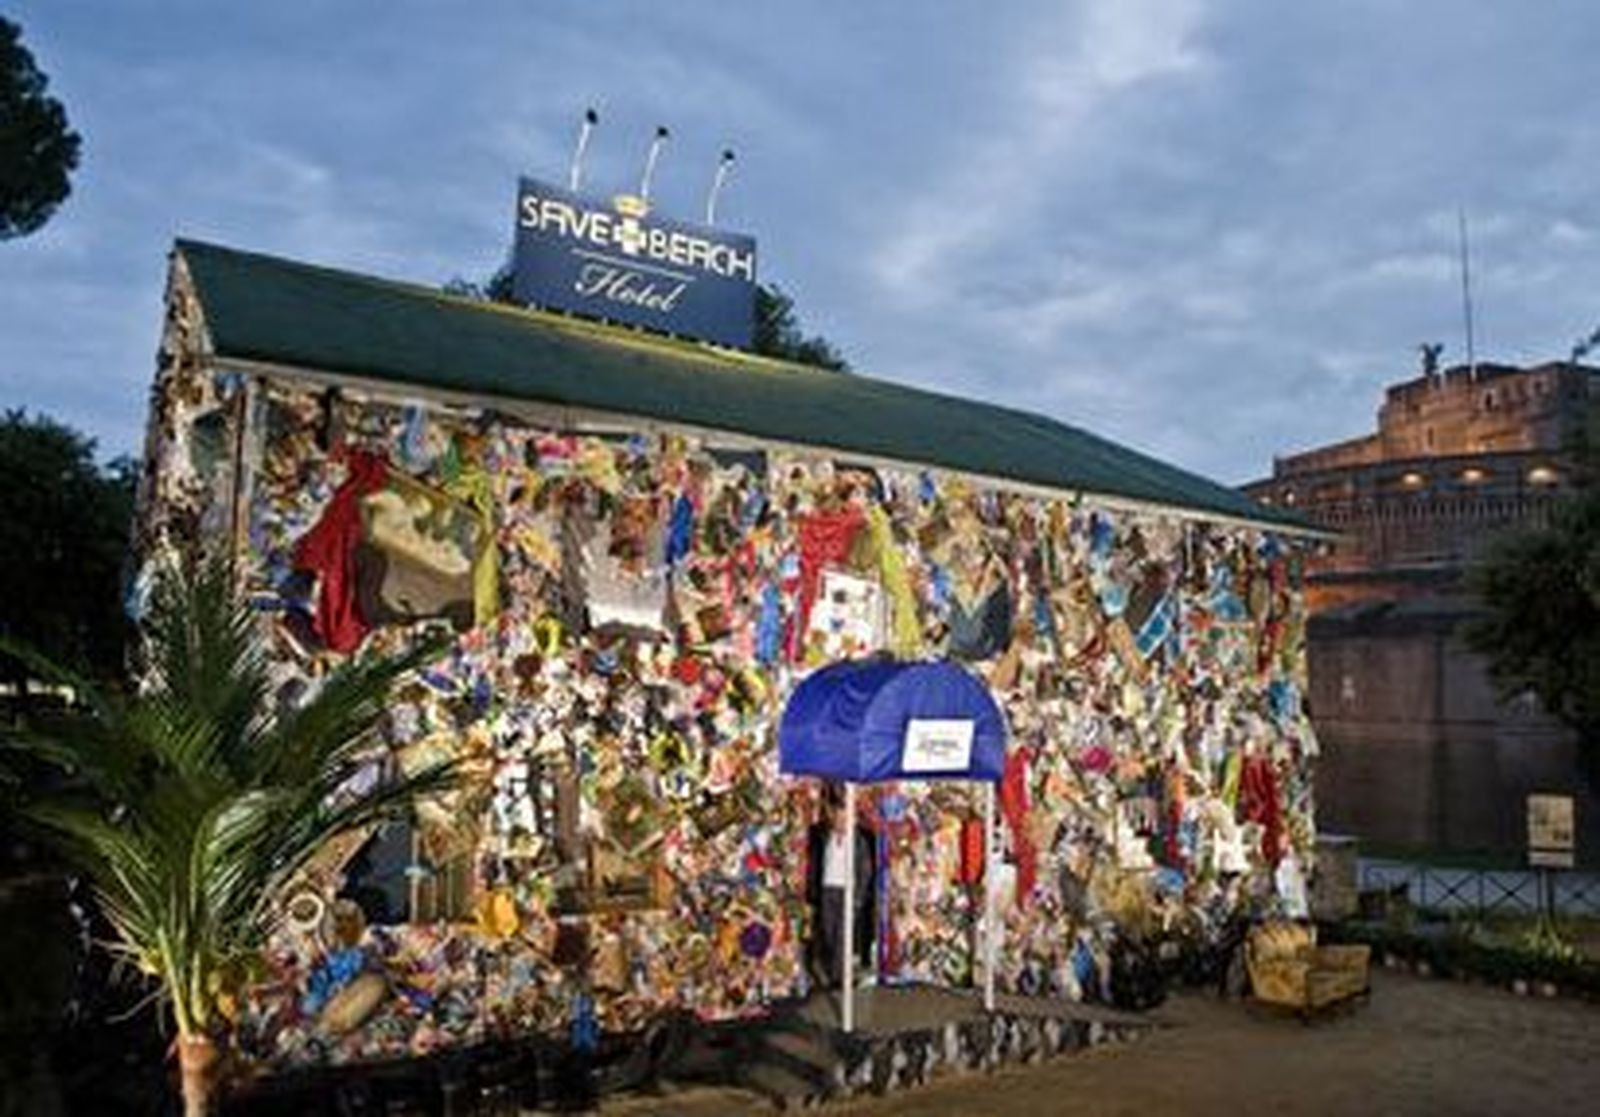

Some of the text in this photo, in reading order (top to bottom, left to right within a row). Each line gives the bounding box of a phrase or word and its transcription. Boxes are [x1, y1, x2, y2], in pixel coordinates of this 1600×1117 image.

[520, 196, 609, 246] SAVE
[650, 229, 753, 281] BEACH
[573, 264, 686, 312] Hotel
